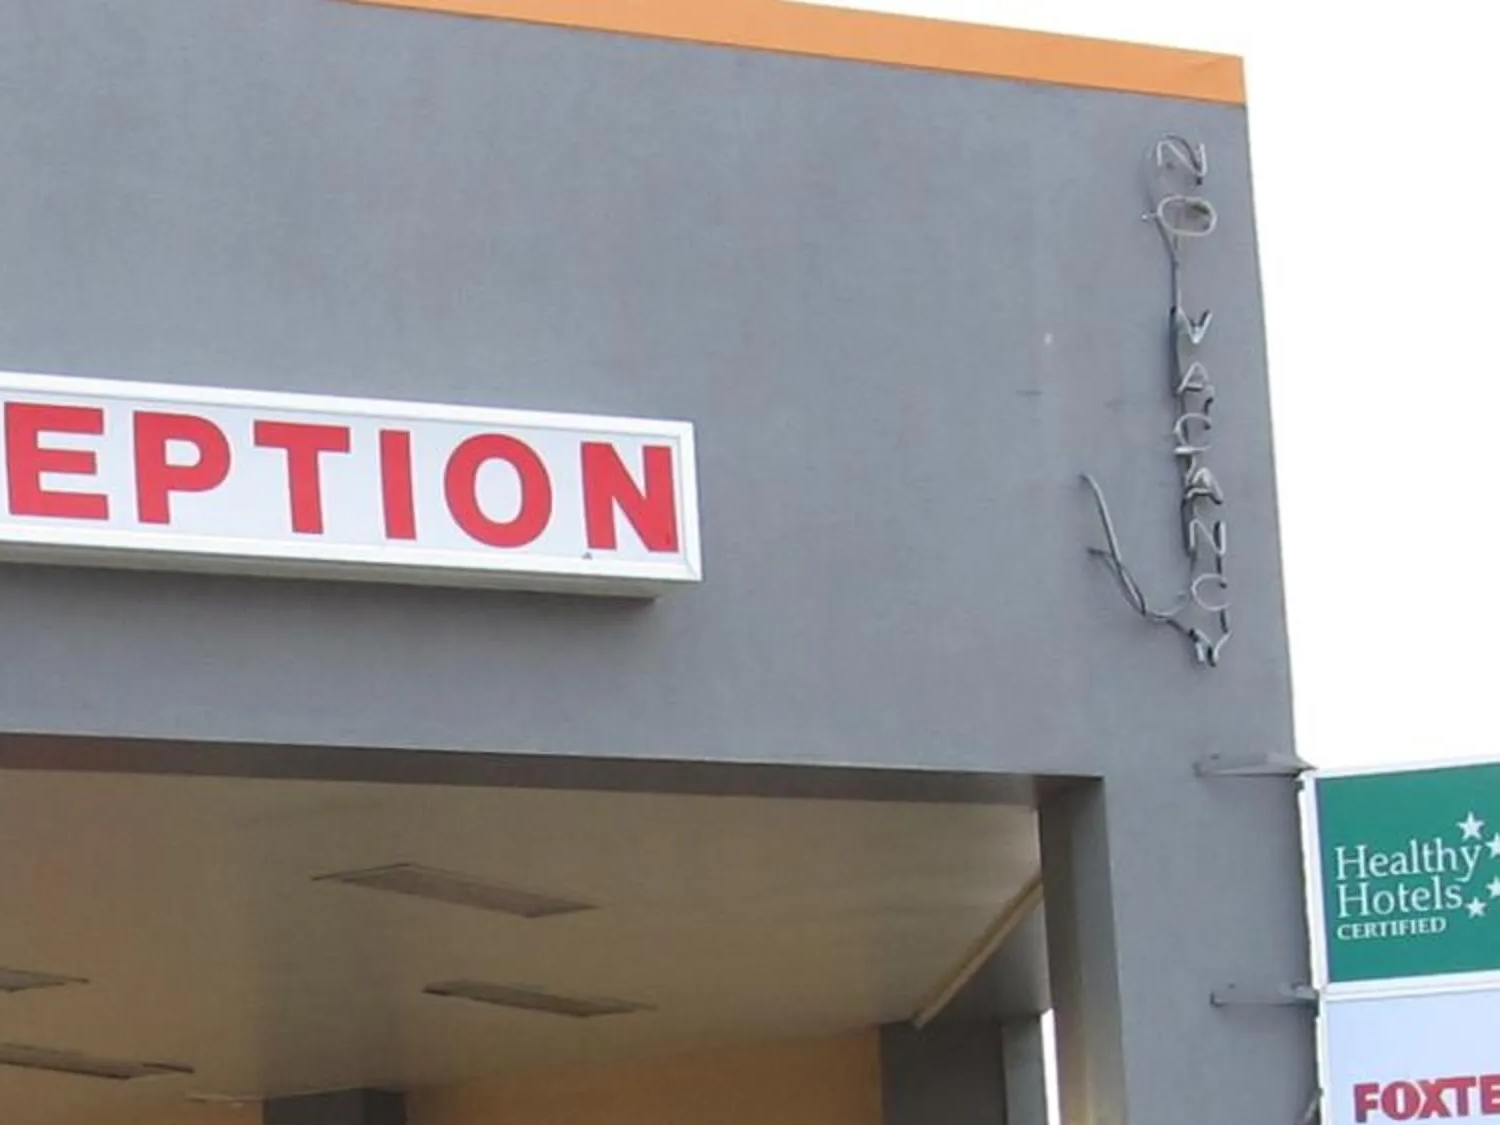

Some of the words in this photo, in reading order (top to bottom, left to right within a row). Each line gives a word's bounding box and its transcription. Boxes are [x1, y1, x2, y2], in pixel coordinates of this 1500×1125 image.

[1334, 836, 1483, 883] Healthy
[1336, 874, 1464, 919] Hotels
[1336, 915, 1447, 941] CERTIFIED
